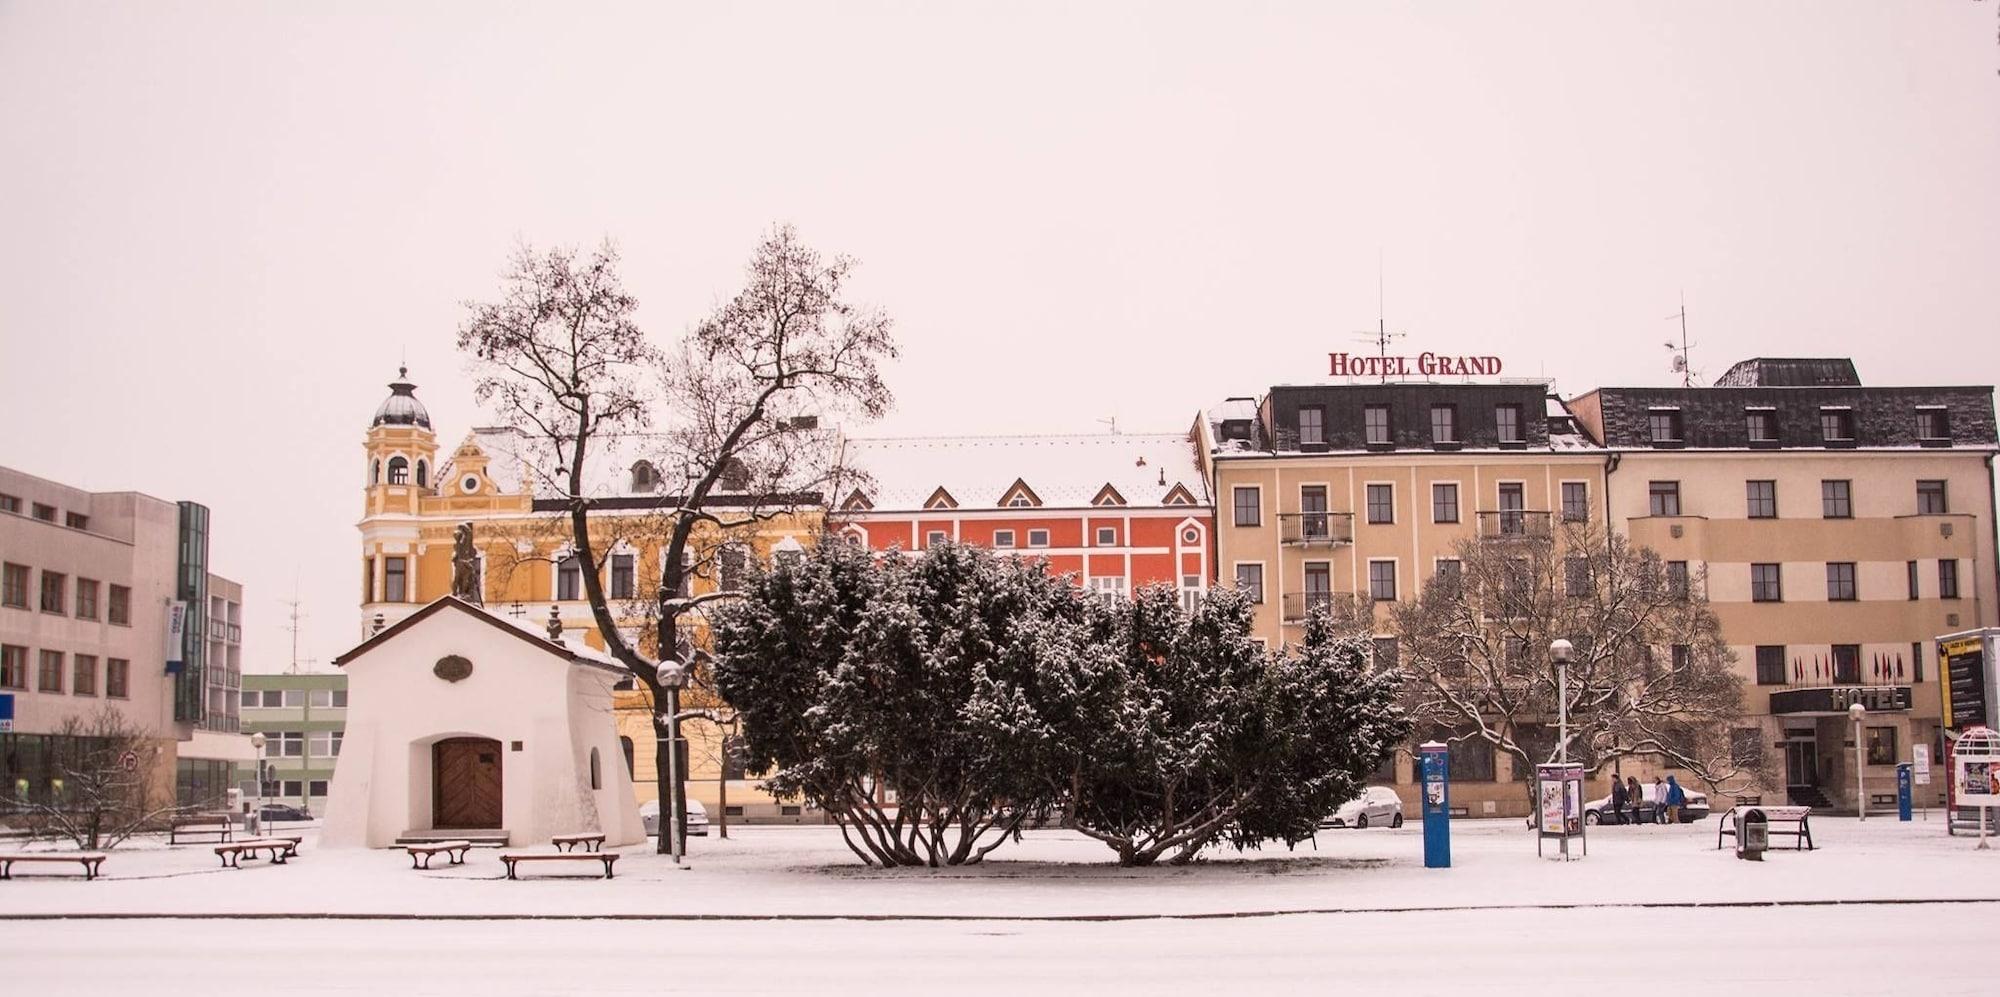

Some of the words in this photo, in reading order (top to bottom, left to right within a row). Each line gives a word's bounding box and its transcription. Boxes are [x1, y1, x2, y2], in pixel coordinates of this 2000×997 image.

[1328, 352, 1410, 376] HOTEL
[1418, 352, 1502, 376] GRAND
[1832, 688, 1905, 710] HOTEL
